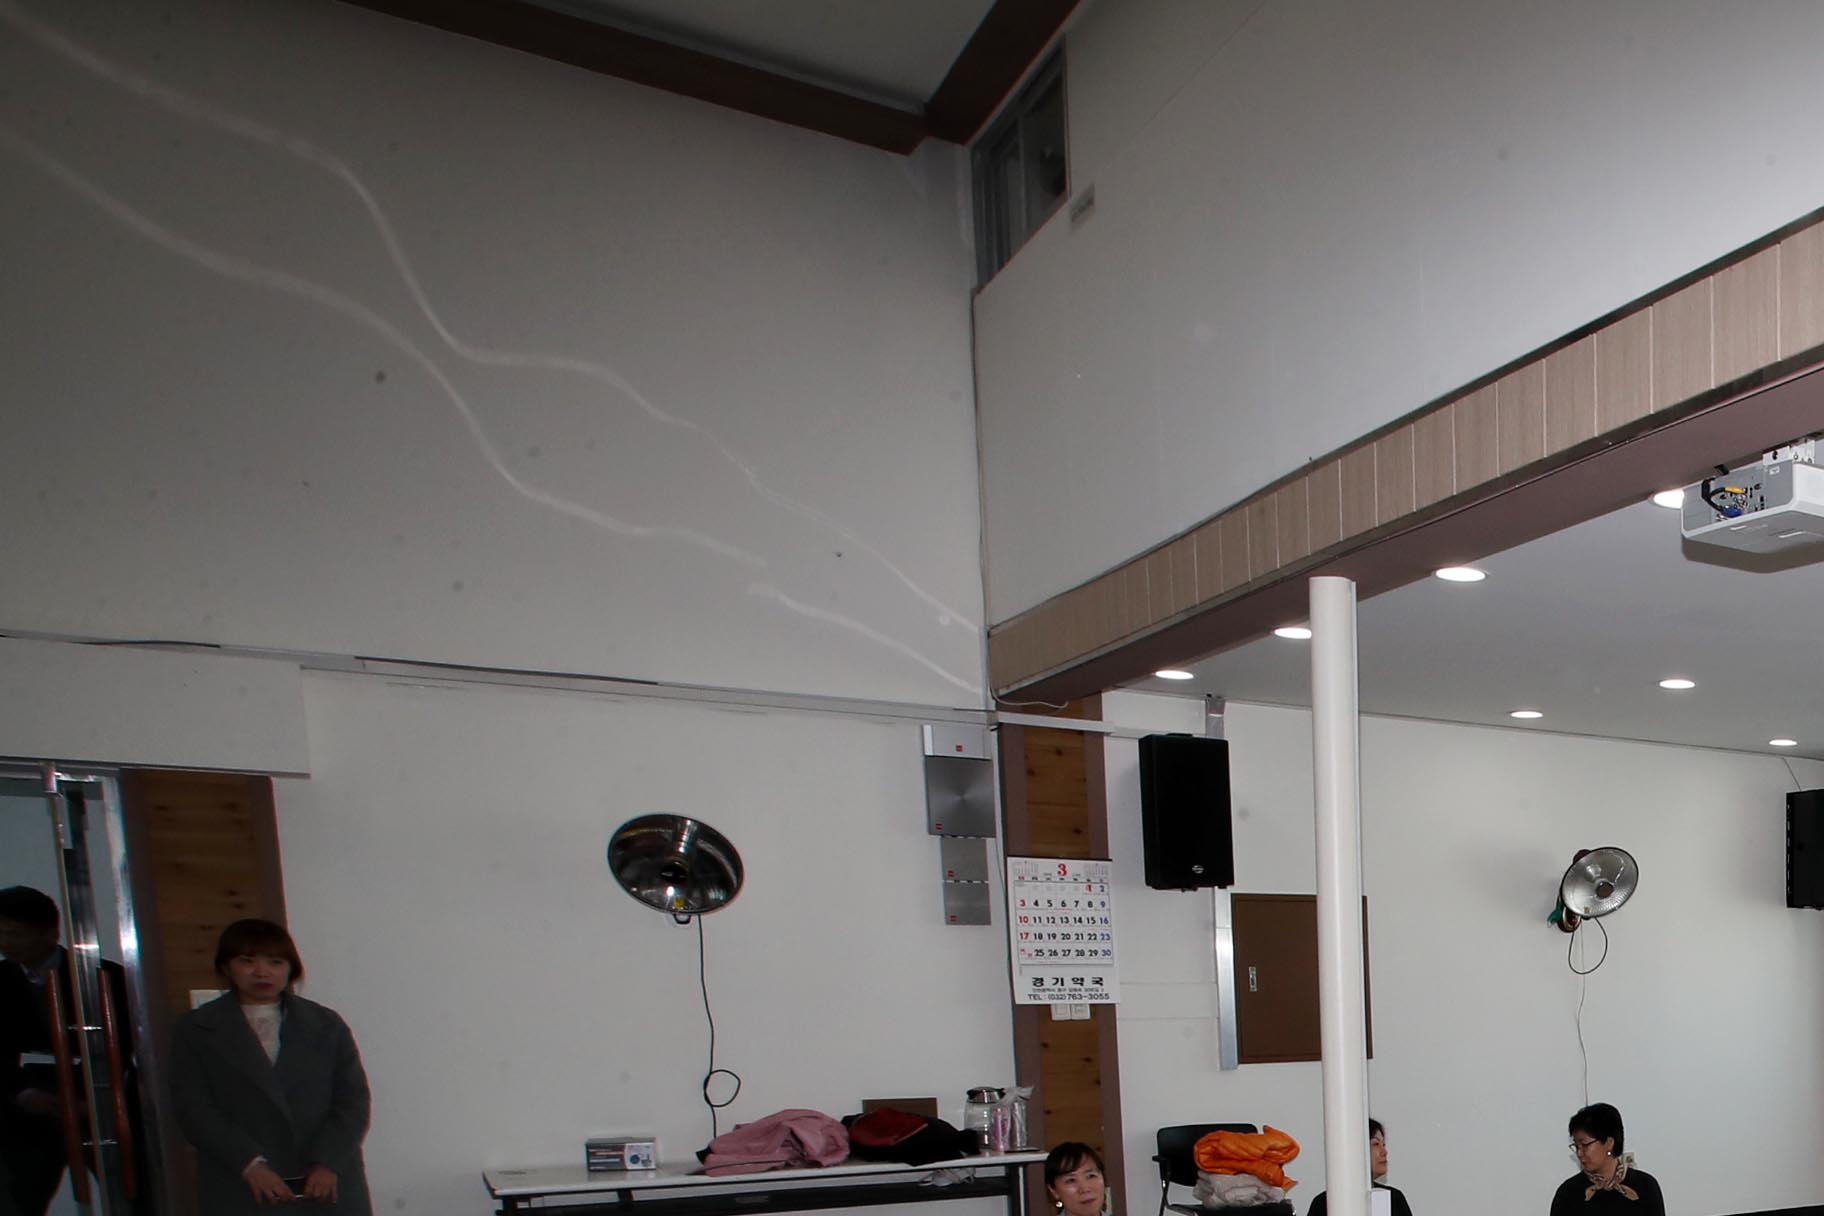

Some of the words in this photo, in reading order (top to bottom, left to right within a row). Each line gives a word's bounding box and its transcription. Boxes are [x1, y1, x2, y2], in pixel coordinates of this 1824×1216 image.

[1058, 863, 1067, 876] 3
[1020, 900, 1026, 908] 3
[1033, 900, 1039, 908] 4
[1047, 900, 1053, 908] 5
[1061, 900, 1066, 908] 6
[1074, 900, 1079, 908] 7
[1087, 900, 1093, 908] 8
[1100, 900, 1105, 908] 9
[1019, 916, 1029, 924] 10
[1033, 916, 1042, 924] 11
[1046, 916, 1056, 924] 12
[1060, 916, 1069, 924] 13
[1073, 916, 1082, 924] 14
[1086, 916, 1096, 924] 15
[1100, 916, 1109, 924] 16
[1020, 932, 1029, 940] 17
[1033, 932, 1043, 940] 18
[1047, 932, 1057, 940] 19
[1061, 932, 1071, 940] 20
[1074, 932, 1084, 940] 21
[1087, 932, 1097, 940] 22
[1100, 932, 1111, 940] 23
[1034, 949, 1045, 957] 25
[1048, 949, 1058, 957] 26
[1061, 949, 1071, 957] 27
[1075, 949, 1085, 957] 28
[1088, 949, 1098, 957] 29
[1102, 949, 1111, 957] 30
